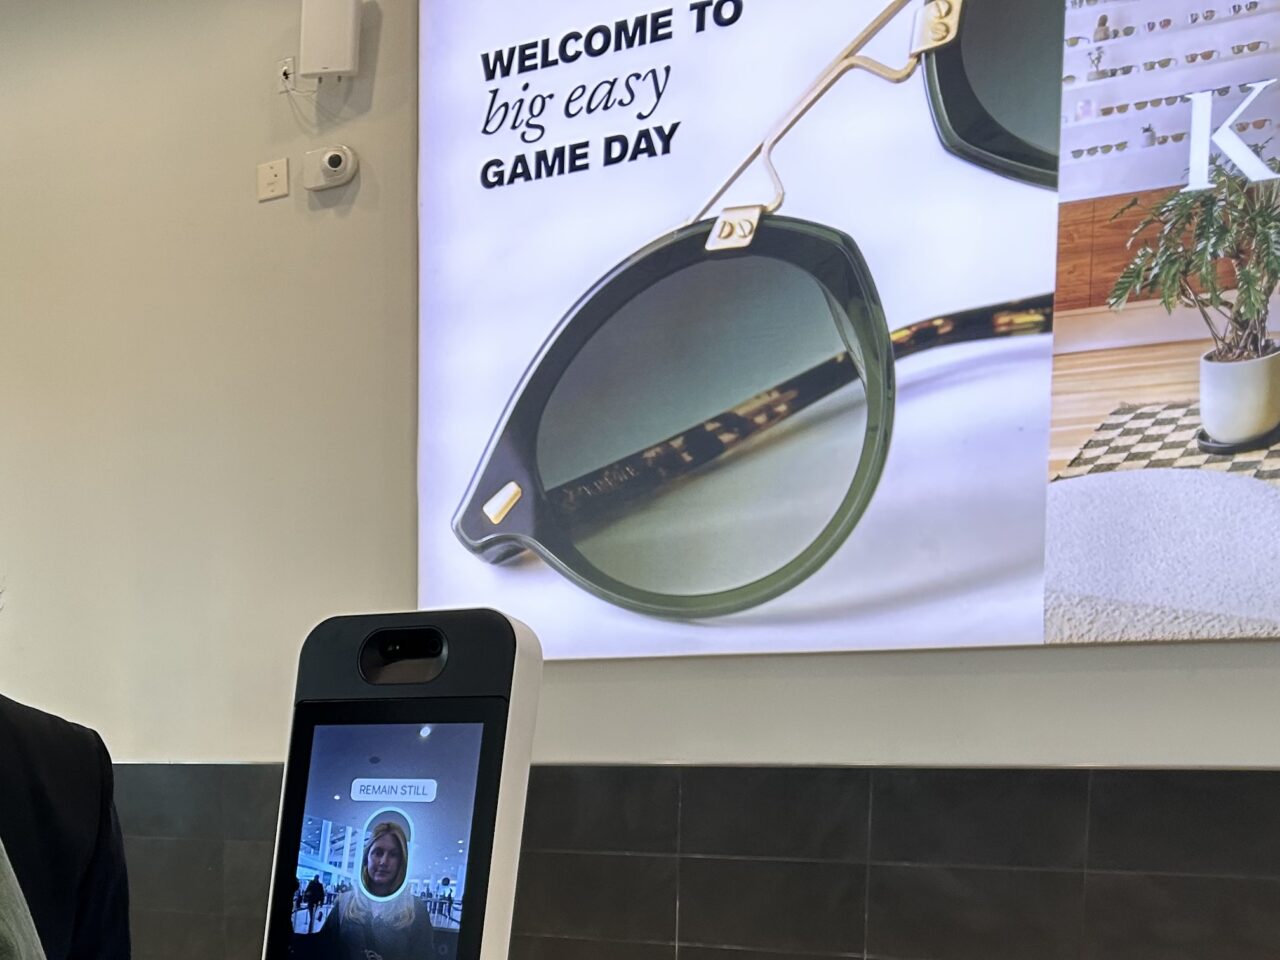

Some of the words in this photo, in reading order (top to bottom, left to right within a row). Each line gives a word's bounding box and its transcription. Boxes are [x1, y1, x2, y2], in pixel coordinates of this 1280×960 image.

[480, 8, 673, 82] WELCOME
[689, 0, 744, 33] TO
[480, 82, 554, 144] big
[563, 64, 671, 120] easy
[480, 140, 590, 189] GAME
[602, 121, 682, 167] DAY
[359, 784, 398, 796] REMAIN
[400, 785, 428, 797] STILL
